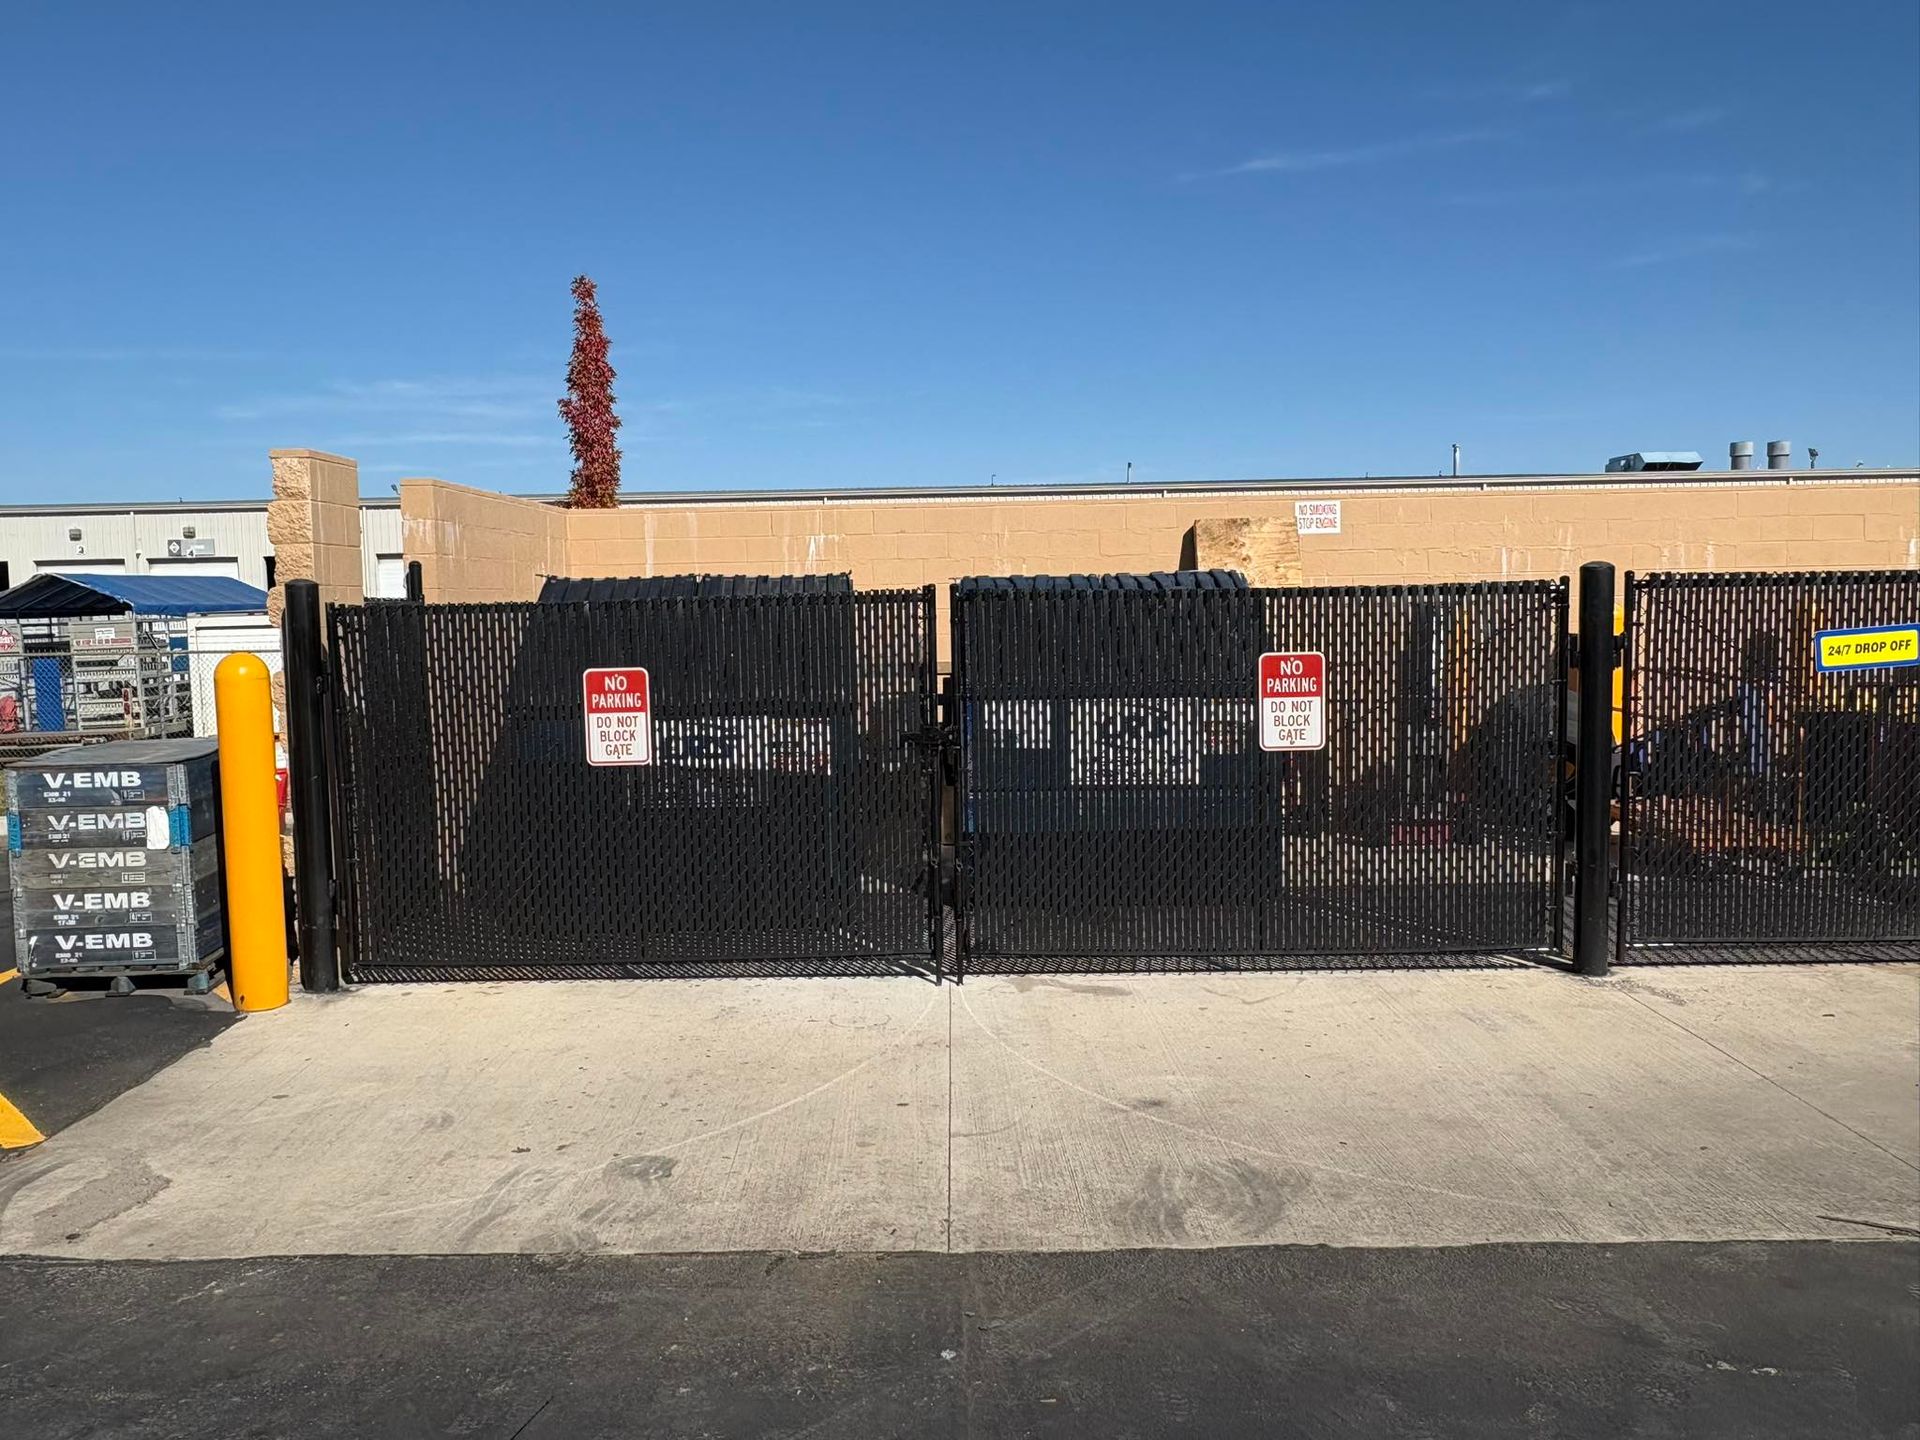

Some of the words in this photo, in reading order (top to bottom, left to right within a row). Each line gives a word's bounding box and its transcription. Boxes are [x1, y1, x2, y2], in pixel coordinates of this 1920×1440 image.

[1298, 504, 1308, 516] NO
[1298, 518, 1314, 530] STOP
[1315, 517, 1338, 529] ENGINE
[1828, 644, 1851, 656] 24/7
[1855, 641, 1887, 654] DROP
[1889, 639, 1912, 652] OFF
[1280, 660, 1303, 676] NO
[604, 675, 627, 691] NO
[1266, 677, 1317, 694] PARKING
[591, 693, 642, 709] PARKING
[1270, 701, 1286, 713] DO
[1291, 700, 1313, 713] NOT
[596, 716, 612, 729] DO
[617, 715, 639, 728] NOT
[1273, 714, 1311, 727] BLOCK
[600, 729, 637, 742] BLOCK
[1278, 728, 1306, 741] GATE
[605, 743, 633, 756] GATE
[42, 771, 142, 789] V-EMB
[47, 812, 146, 831] V-EMB
[47, 851, 147, 869] V-EMB
[52, 892, 151, 911] V-EMB
[54, 933, 153, 950] V-EMB
